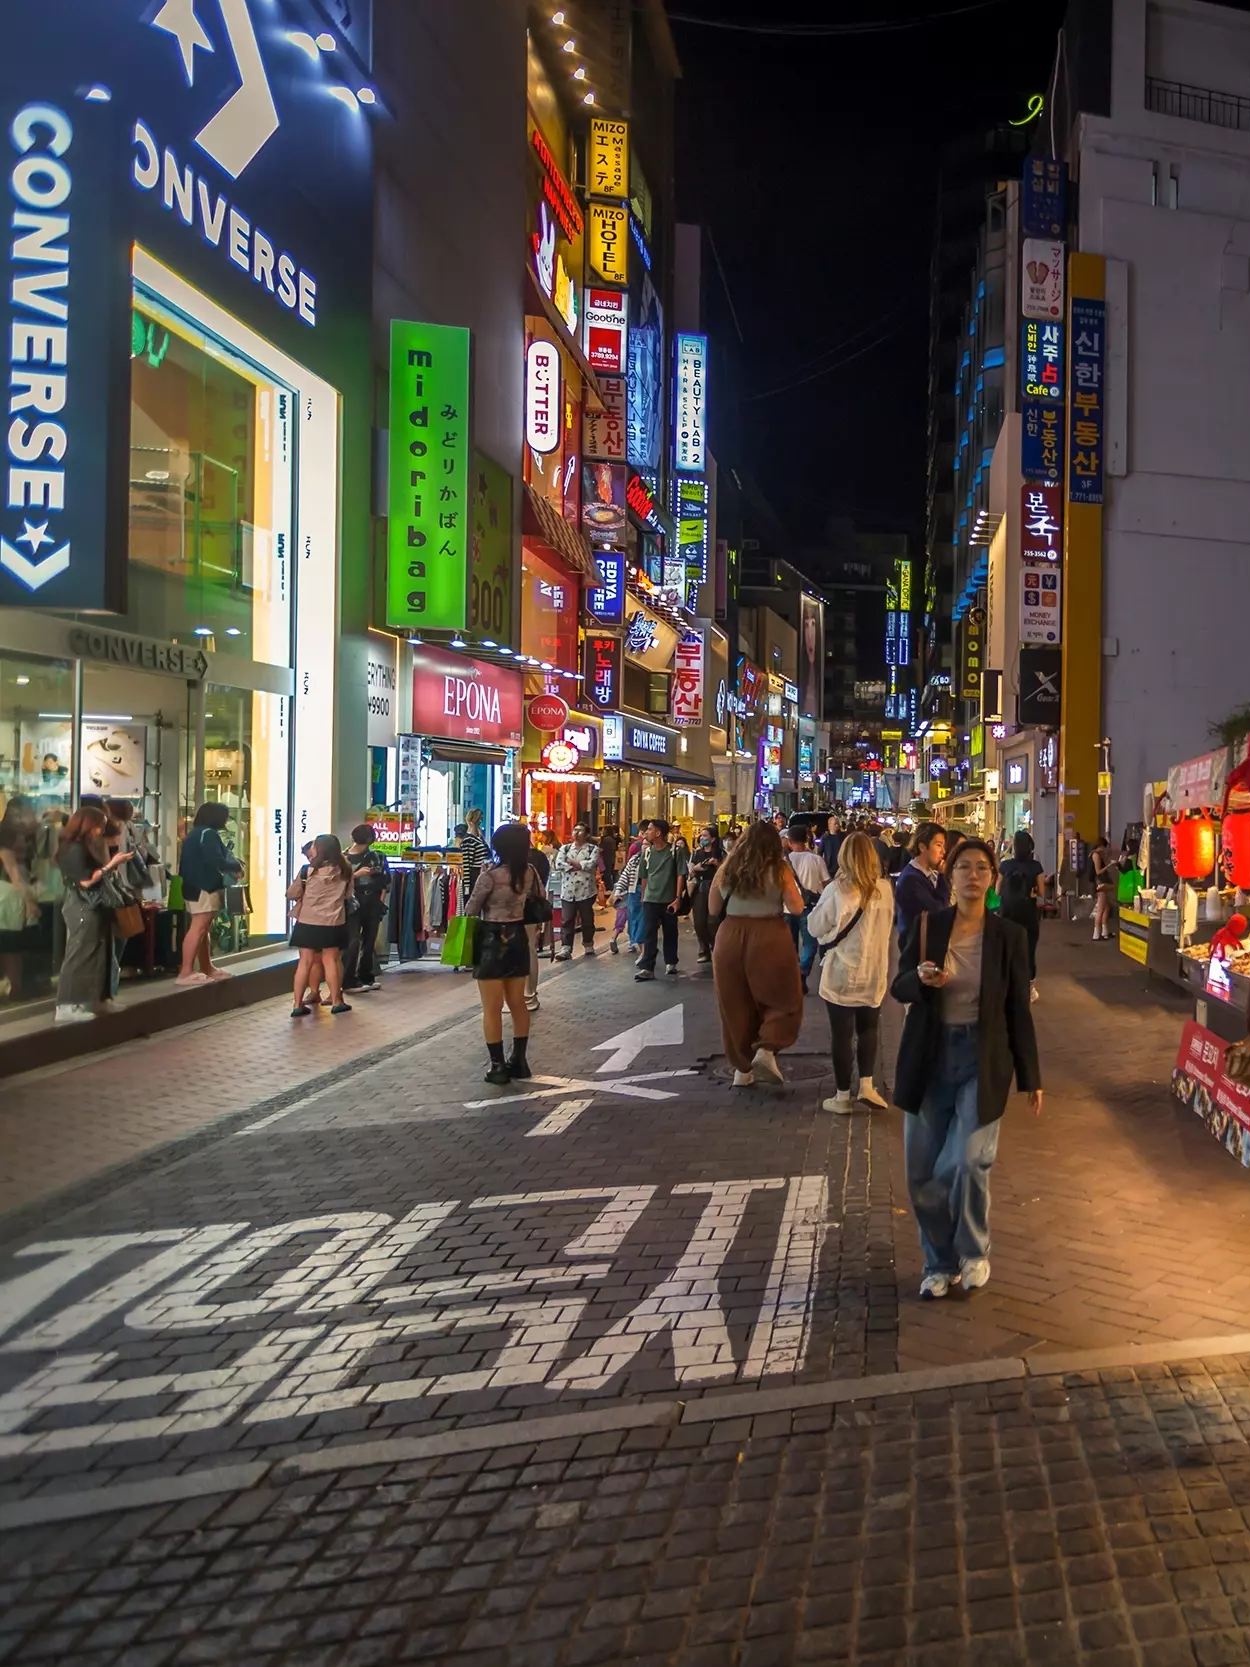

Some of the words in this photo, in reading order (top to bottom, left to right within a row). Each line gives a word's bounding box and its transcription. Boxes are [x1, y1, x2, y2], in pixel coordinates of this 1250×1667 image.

[593, 121, 626, 135] MIZO
[596, 135, 608, 185] エステ
[612, 137, 624, 187] Massage
[603, 185, 615, 193] 8F
[132, 117, 317, 326] ONVERSE
[593, 208, 625, 221] MIZO
[600, 220, 617, 273] HOTEL
[614, 273, 625, 281] 8F
[1050, 247, 1061, 302] マッサージ
[7, 103, 73, 511] CONVERSE
[1027, 323, 1037, 352] 신비안
[692, 360, 702, 415] BEAUTY
[1026, 383, 1049, 396] Cafe
[602, 380, 624, 456] 부동산
[692, 419, 701, 448] LAB
[1041, 409, 1058, 467] 부동산
[407, 349, 433, 613] midoribag
[438, 404, 459, 557] みどりかばん
[692, 453, 700, 464] 2
[1081, 480, 1092, 489] 3F
[1024, 492, 1060, 546] 본죽
[593, 559, 606, 611] COFEE
[605, 561, 618, 600] EDIYA
[1023, 618, 1057, 627] EXCHANGE
[1029, 611, 1052, 619] MONEY
[68, 628, 195, 674] CONVERSE
[443, 675, 502, 724] EPONA
[594, 653, 613, 704] 노래방
[674, 643, 703, 717] 부동산
[531, 707, 565, 716] EPONA
